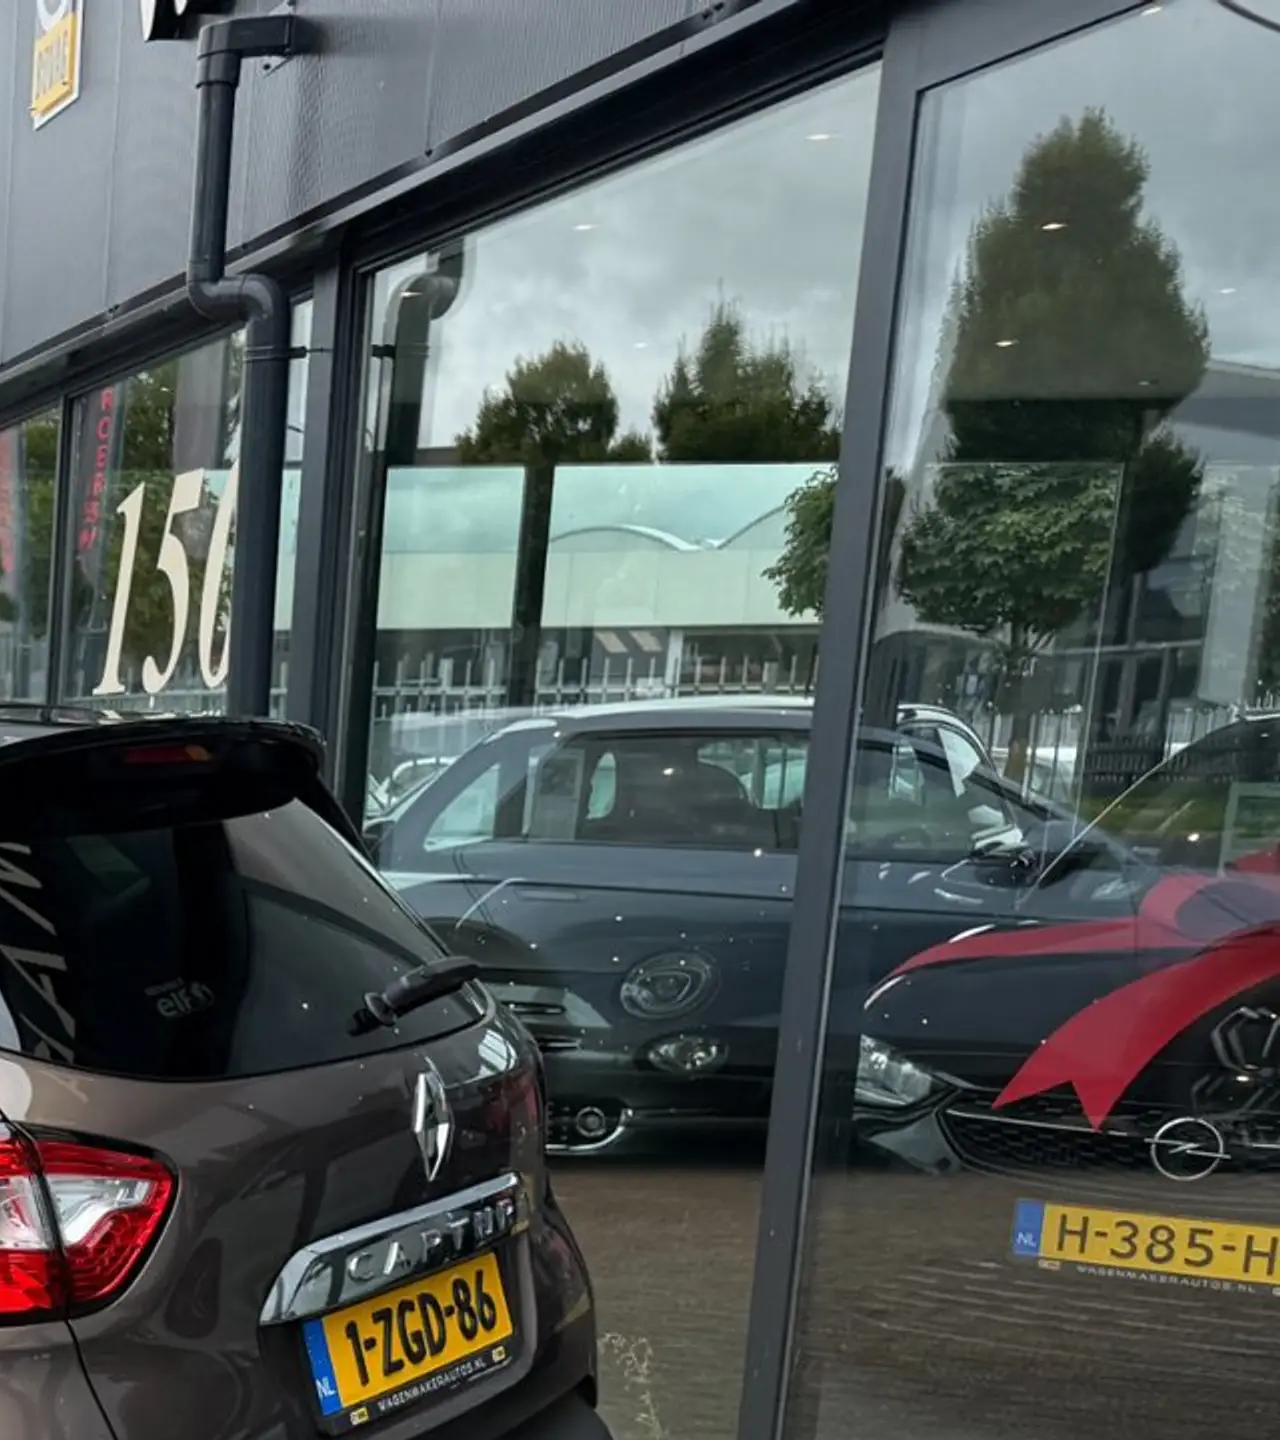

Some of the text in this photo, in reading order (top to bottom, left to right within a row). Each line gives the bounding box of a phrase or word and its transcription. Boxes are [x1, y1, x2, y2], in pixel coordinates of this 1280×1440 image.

[1016, 1231, 1037, 1247] NL
[1056, 1213, 1279, 1277] H-385-H
[345, 1269, 497, 1387] 1-ZGD-86
[315, 1376, 336, 1401] NL
